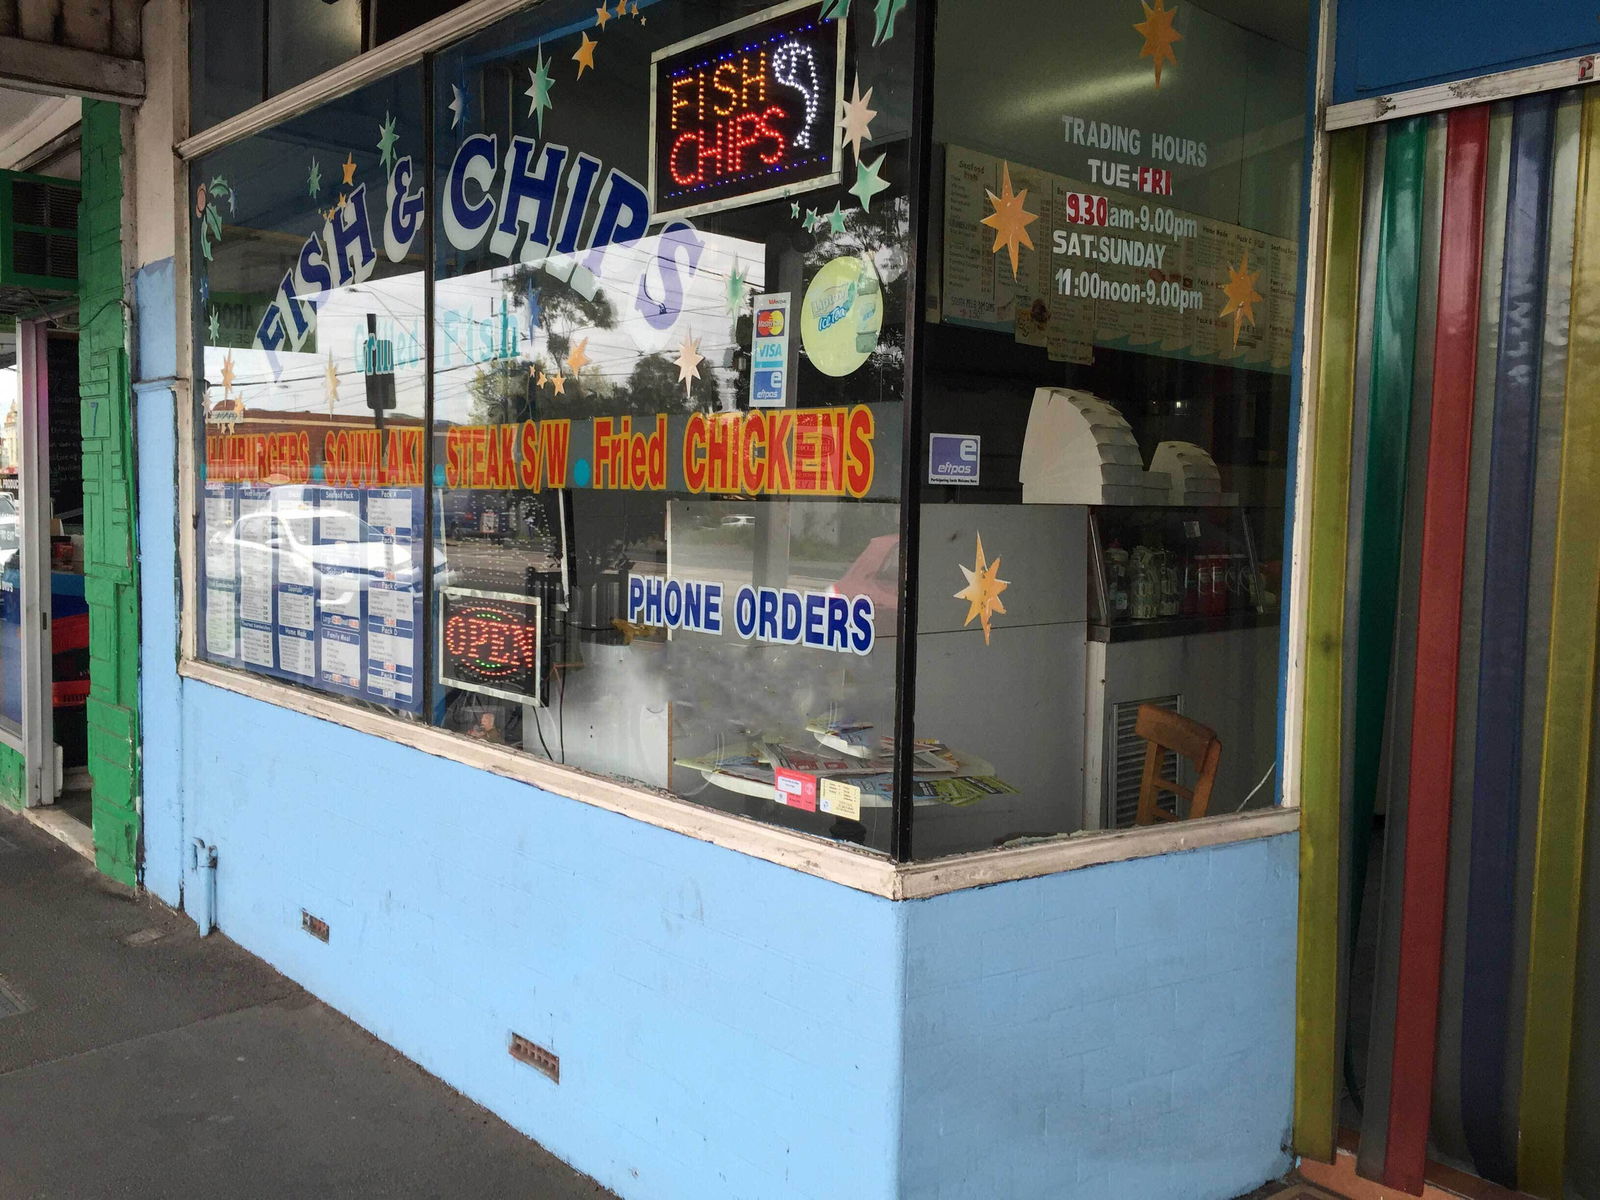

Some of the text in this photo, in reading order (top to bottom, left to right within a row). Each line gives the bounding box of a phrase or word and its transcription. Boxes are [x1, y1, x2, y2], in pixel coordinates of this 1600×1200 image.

[670, 50, 767, 130] FISH
[670, 104, 786, 186] CHIPS
[1061, 114, 1208, 168] TRADING HOURS
[1087, 158, 1173, 197] TUE-FRI
[252, 133, 706, 381] FISH & CHIPS
[442, 297, 521, 366] Fish
[759, 343, 783, 358] VISA
[206, 404, 875, 498] HAMBURGERS SOUVLAKI STEAK S/W Fried CHICKENS
[937, 461, 972, 475] eftpos
[627, 573, 876, 656] PHONE ORDERS
